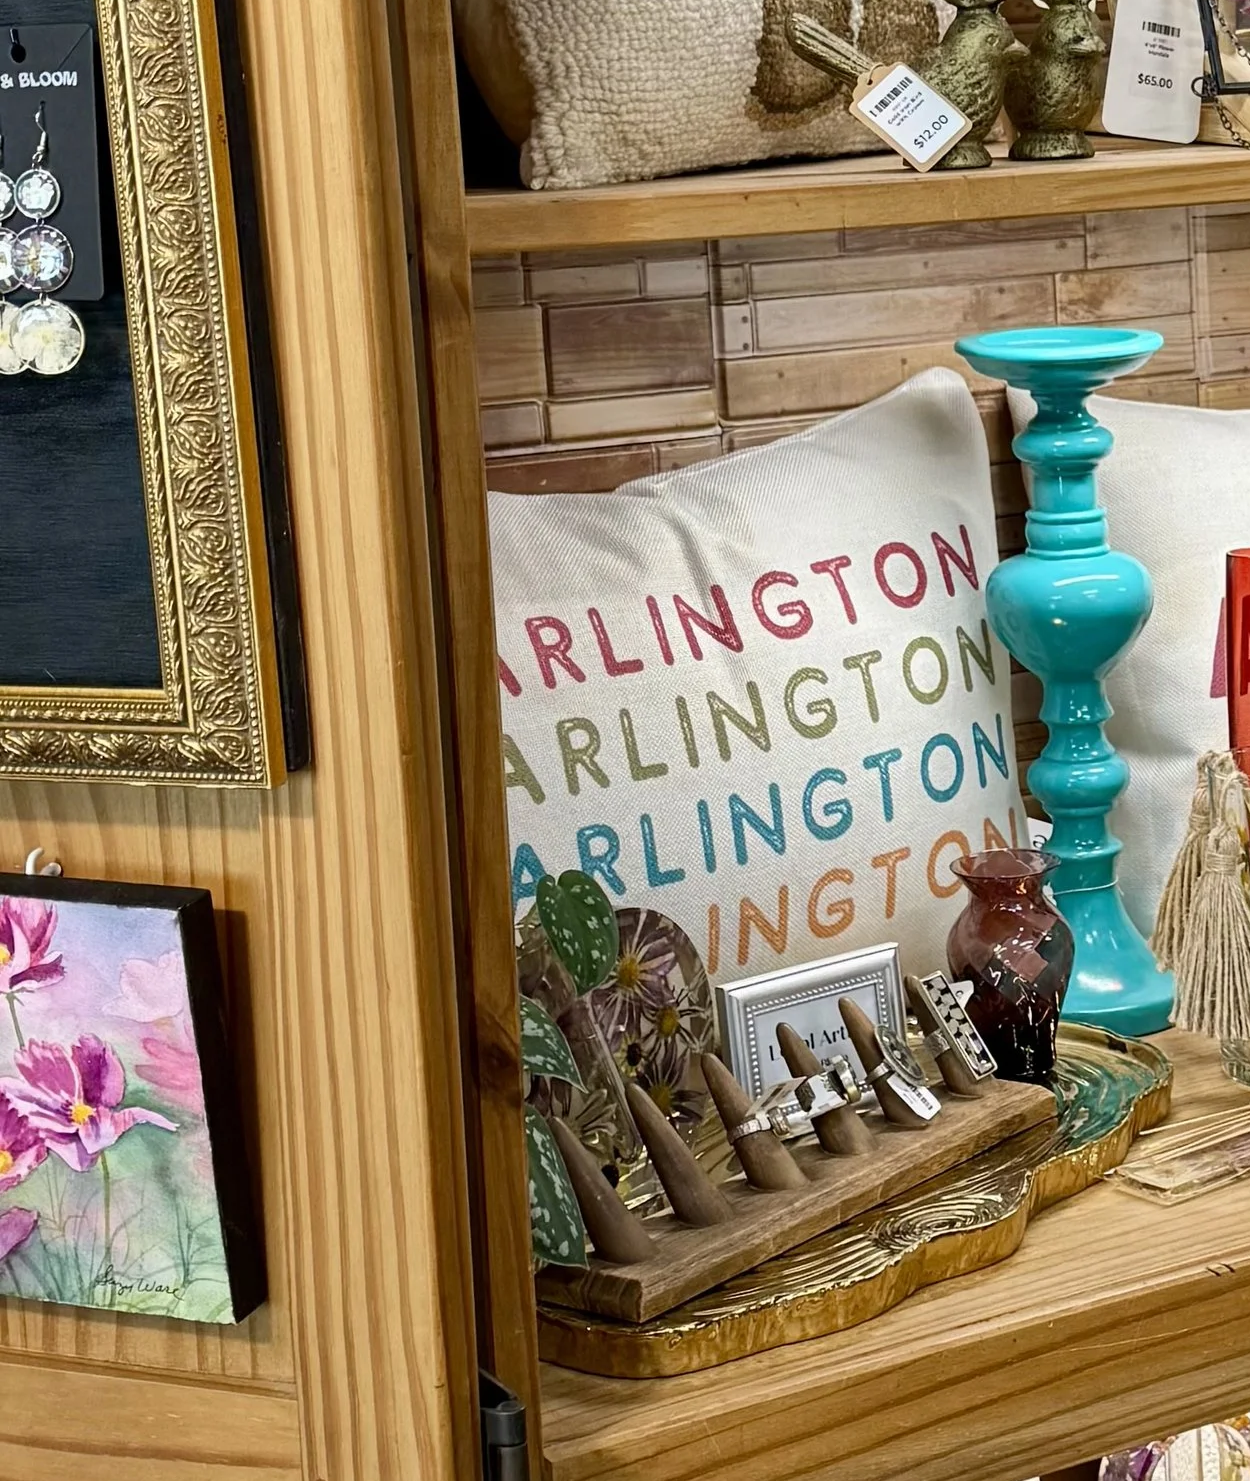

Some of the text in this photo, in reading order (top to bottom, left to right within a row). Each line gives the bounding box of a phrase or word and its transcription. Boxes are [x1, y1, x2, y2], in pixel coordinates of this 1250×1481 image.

[18, 71, 78, 88] BLOOM
[1137, 72, 1173, 89] $65.00
[913, 114, 949, 149] $12.00
[502, 619, 996, 805] ARLINGTON
[511, 714, 1010, 912] ARLINGTON
[707, 807, 1018, 976] INGTON
[819, 1026, 849, 1048] Art
